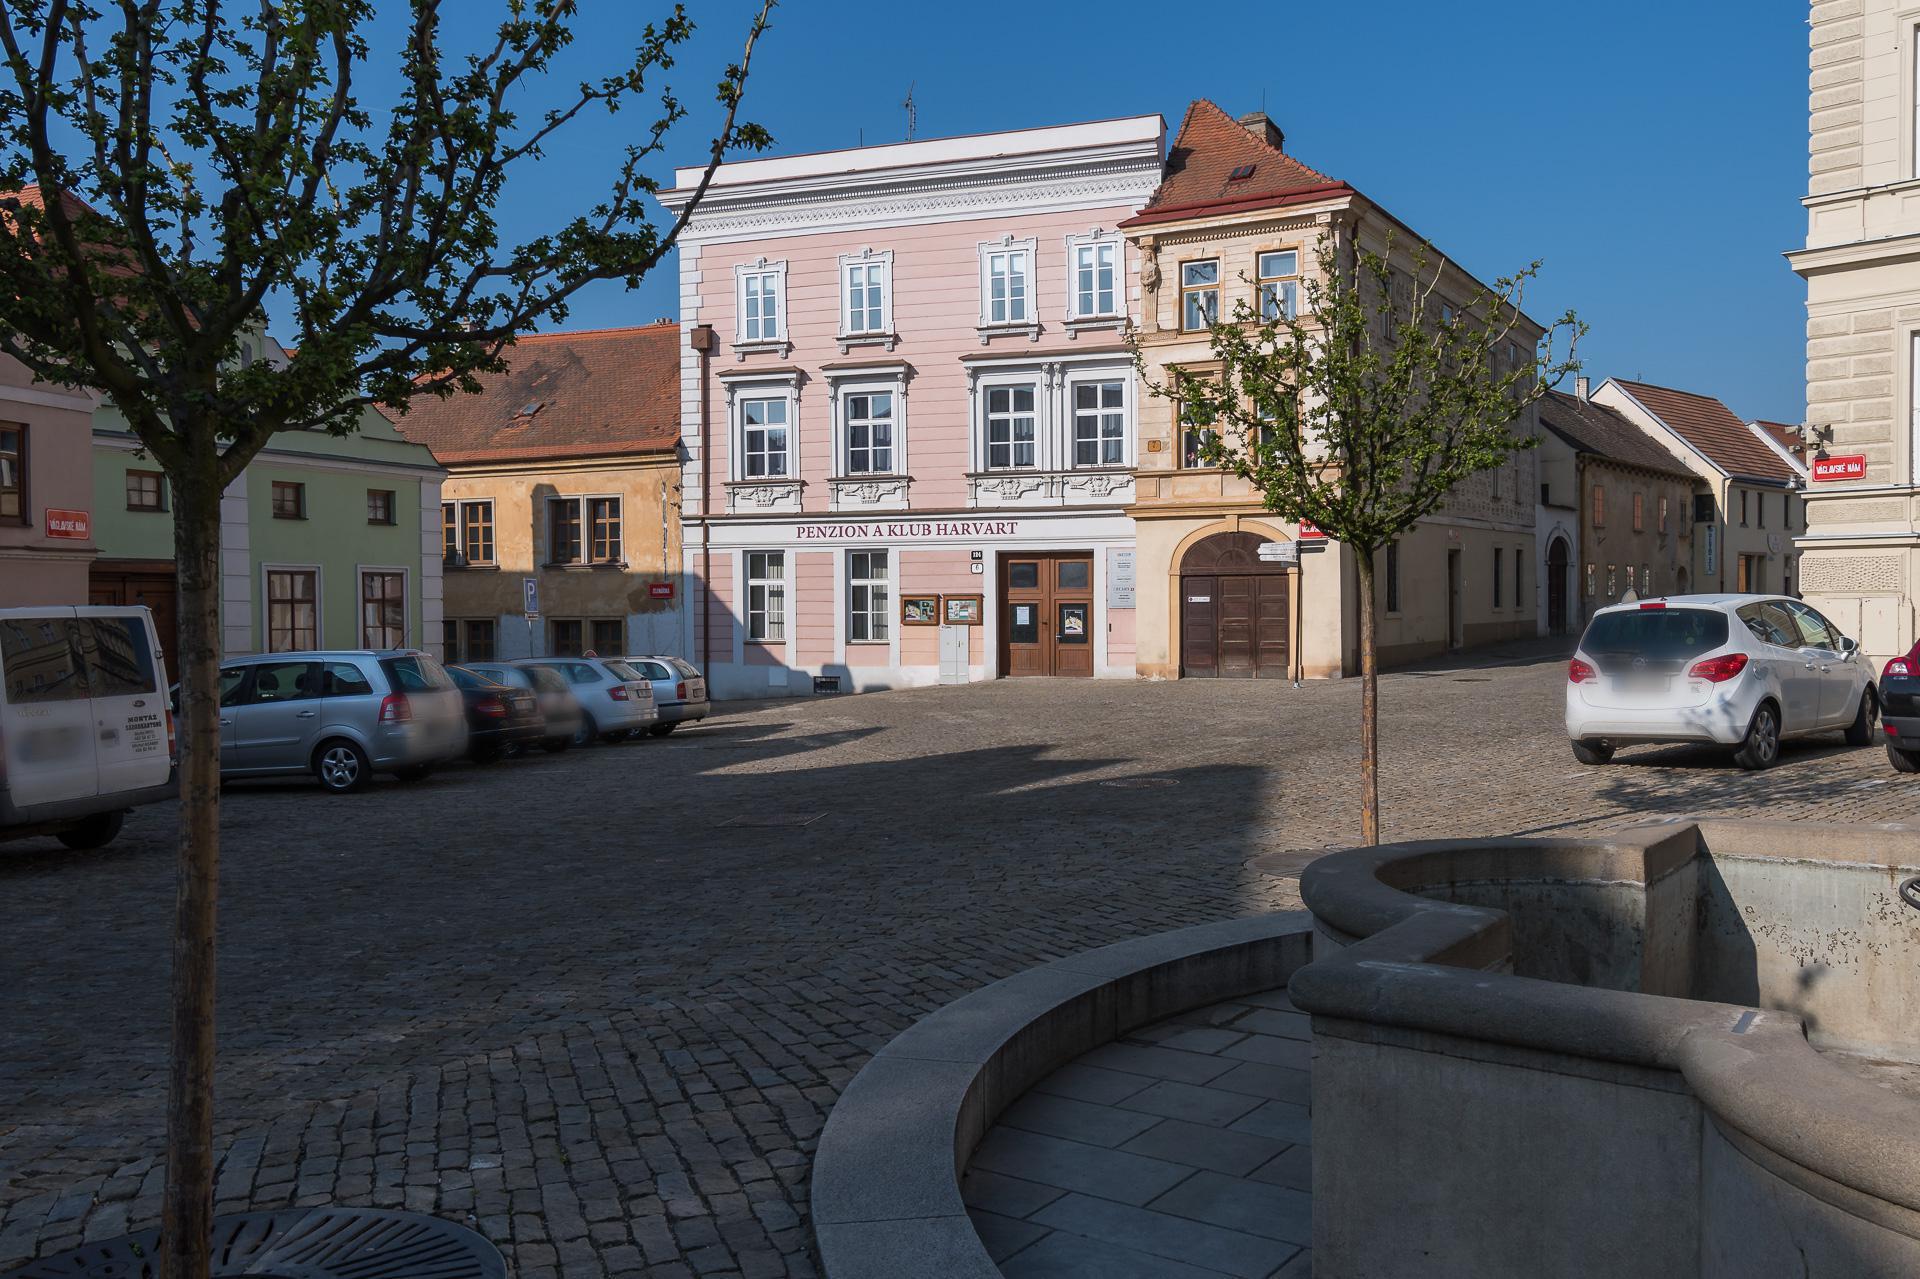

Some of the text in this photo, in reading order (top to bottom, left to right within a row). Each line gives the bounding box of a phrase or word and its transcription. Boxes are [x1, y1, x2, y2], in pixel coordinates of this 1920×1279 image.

[1816, 463, 1846, 475] VÁCLAVSKÉ
[796, 521, 1018, 538] PENZION A KLUB HARVART
[527, 582, 535, 602] P
